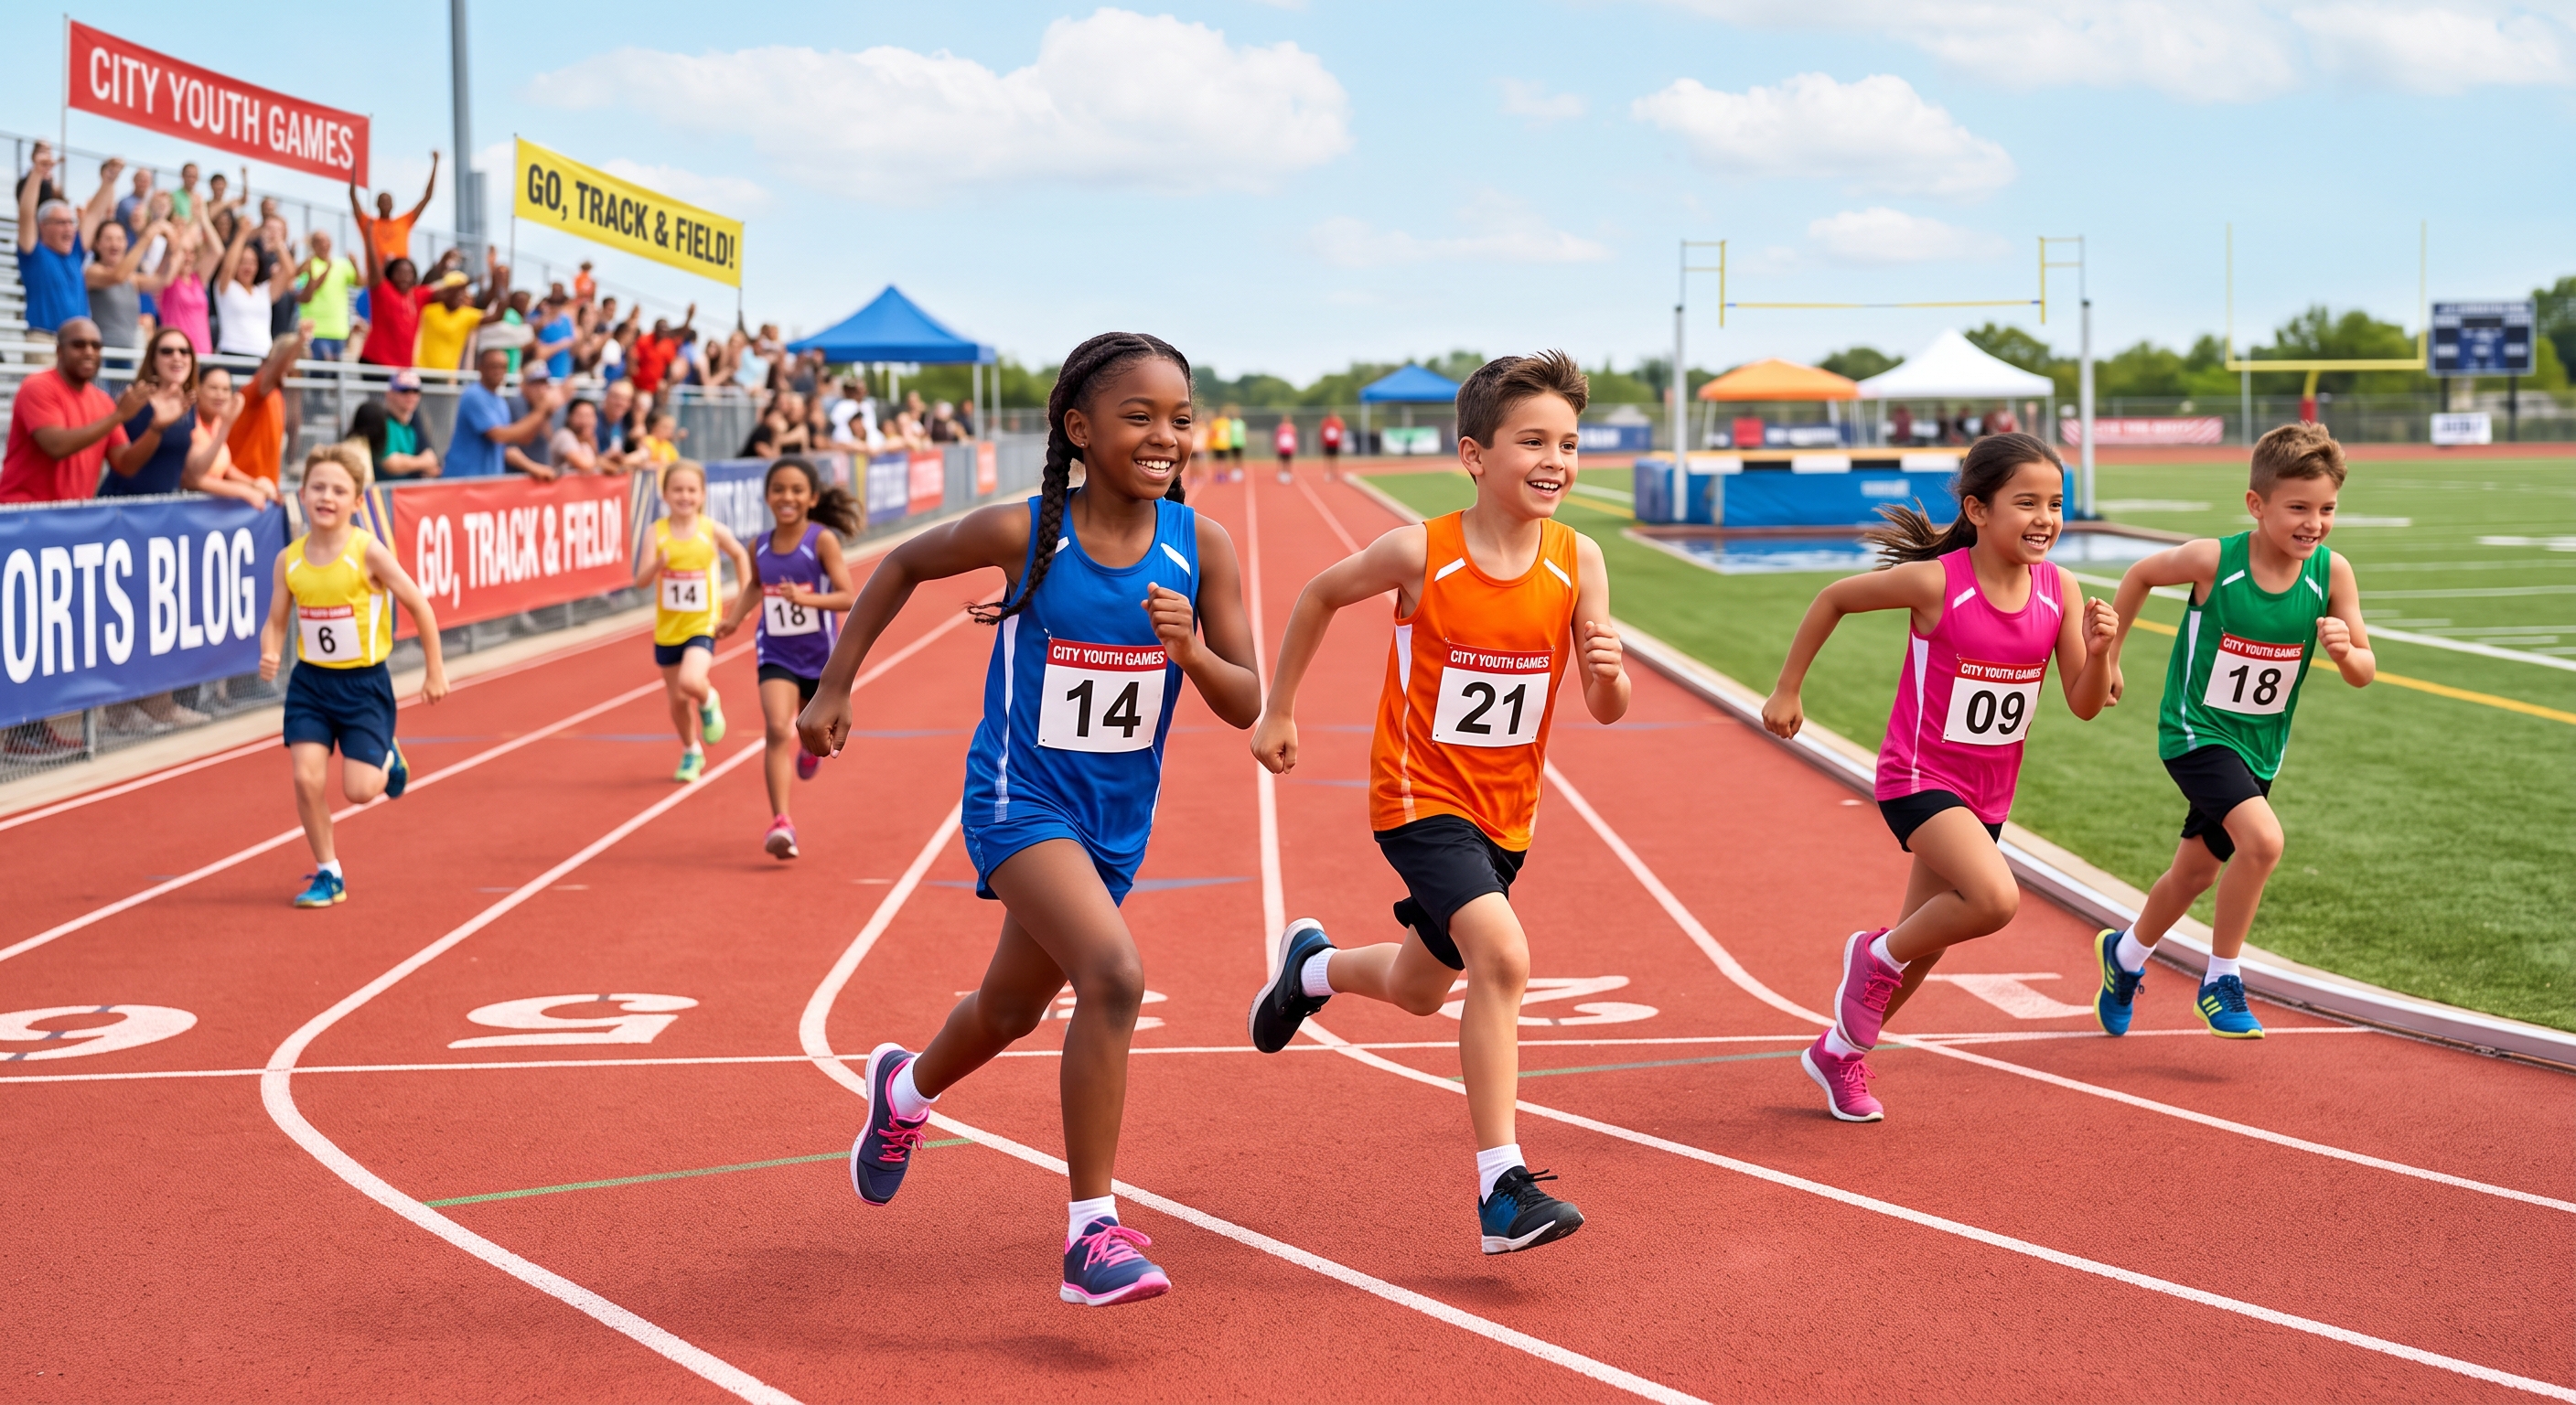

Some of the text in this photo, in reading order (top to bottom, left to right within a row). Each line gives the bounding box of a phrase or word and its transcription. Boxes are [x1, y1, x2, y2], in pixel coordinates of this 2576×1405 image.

[91, 47, 355, 170] CITY YOUTH GAMES
[527, 163, 735, 270] GO, TRACK & FIELD!
[416, 514, 461, 610] GO,
[463, 506, 541, 590] TRACK
[542, 503, 561, 577] &
[563, 495, 623, 574] FIELD!
[2, 527, 256, 684] ORTS BLOG
[671, 584, 696, 604] 14
[774, 602, 806, 627] 18
[318, 626, 337, 654] 6
[1053, 645, 1165, 666] CITY YOUTH GAMES
[1450, 649, 1550, 670] CITY YOUTH GAMES
[2223, 638, 2245, 651] CITY
[2245, 643, 2274, 657] YOUTH
[1960, 663, 2043, 681] CITY YOUTH GAMES
[2228, 664, 2282, 706] 18
[1066, 679, 1143, 738] 14
[1454, 681, 1527, 735] 21
[1966, 690, 2025, 735] 09
[446, 992, 700, 1049] 5
